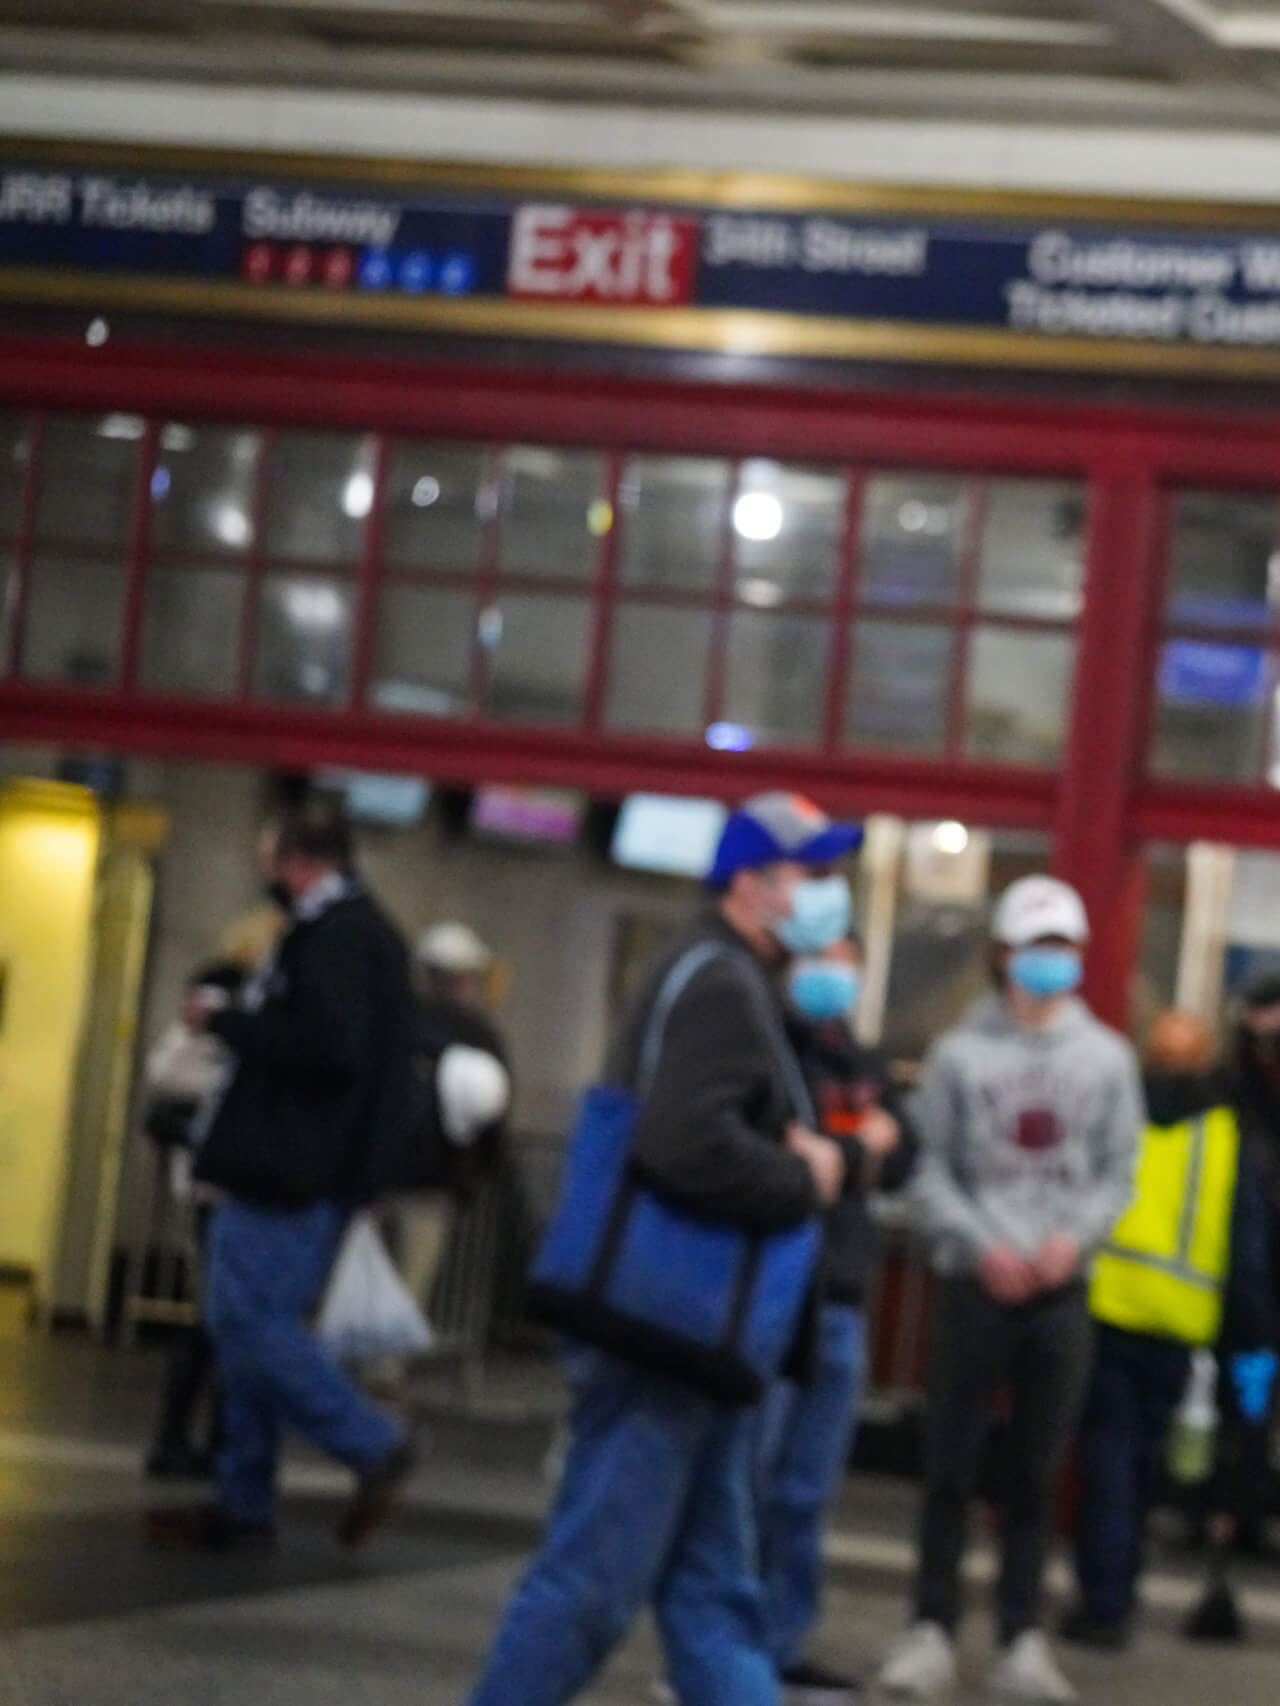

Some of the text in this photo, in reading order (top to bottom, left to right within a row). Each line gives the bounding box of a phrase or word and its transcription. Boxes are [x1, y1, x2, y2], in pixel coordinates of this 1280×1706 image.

[84, 176, 216, 235] Tickets
[243, 185, 402, 247] Subway
[509, 203, 672, 301] Exit
[705, 215, 928, 276] 34th Street
[1029, 229, 1234, 286] Customer
[1008, 280, 1181, 336] Ticketed
